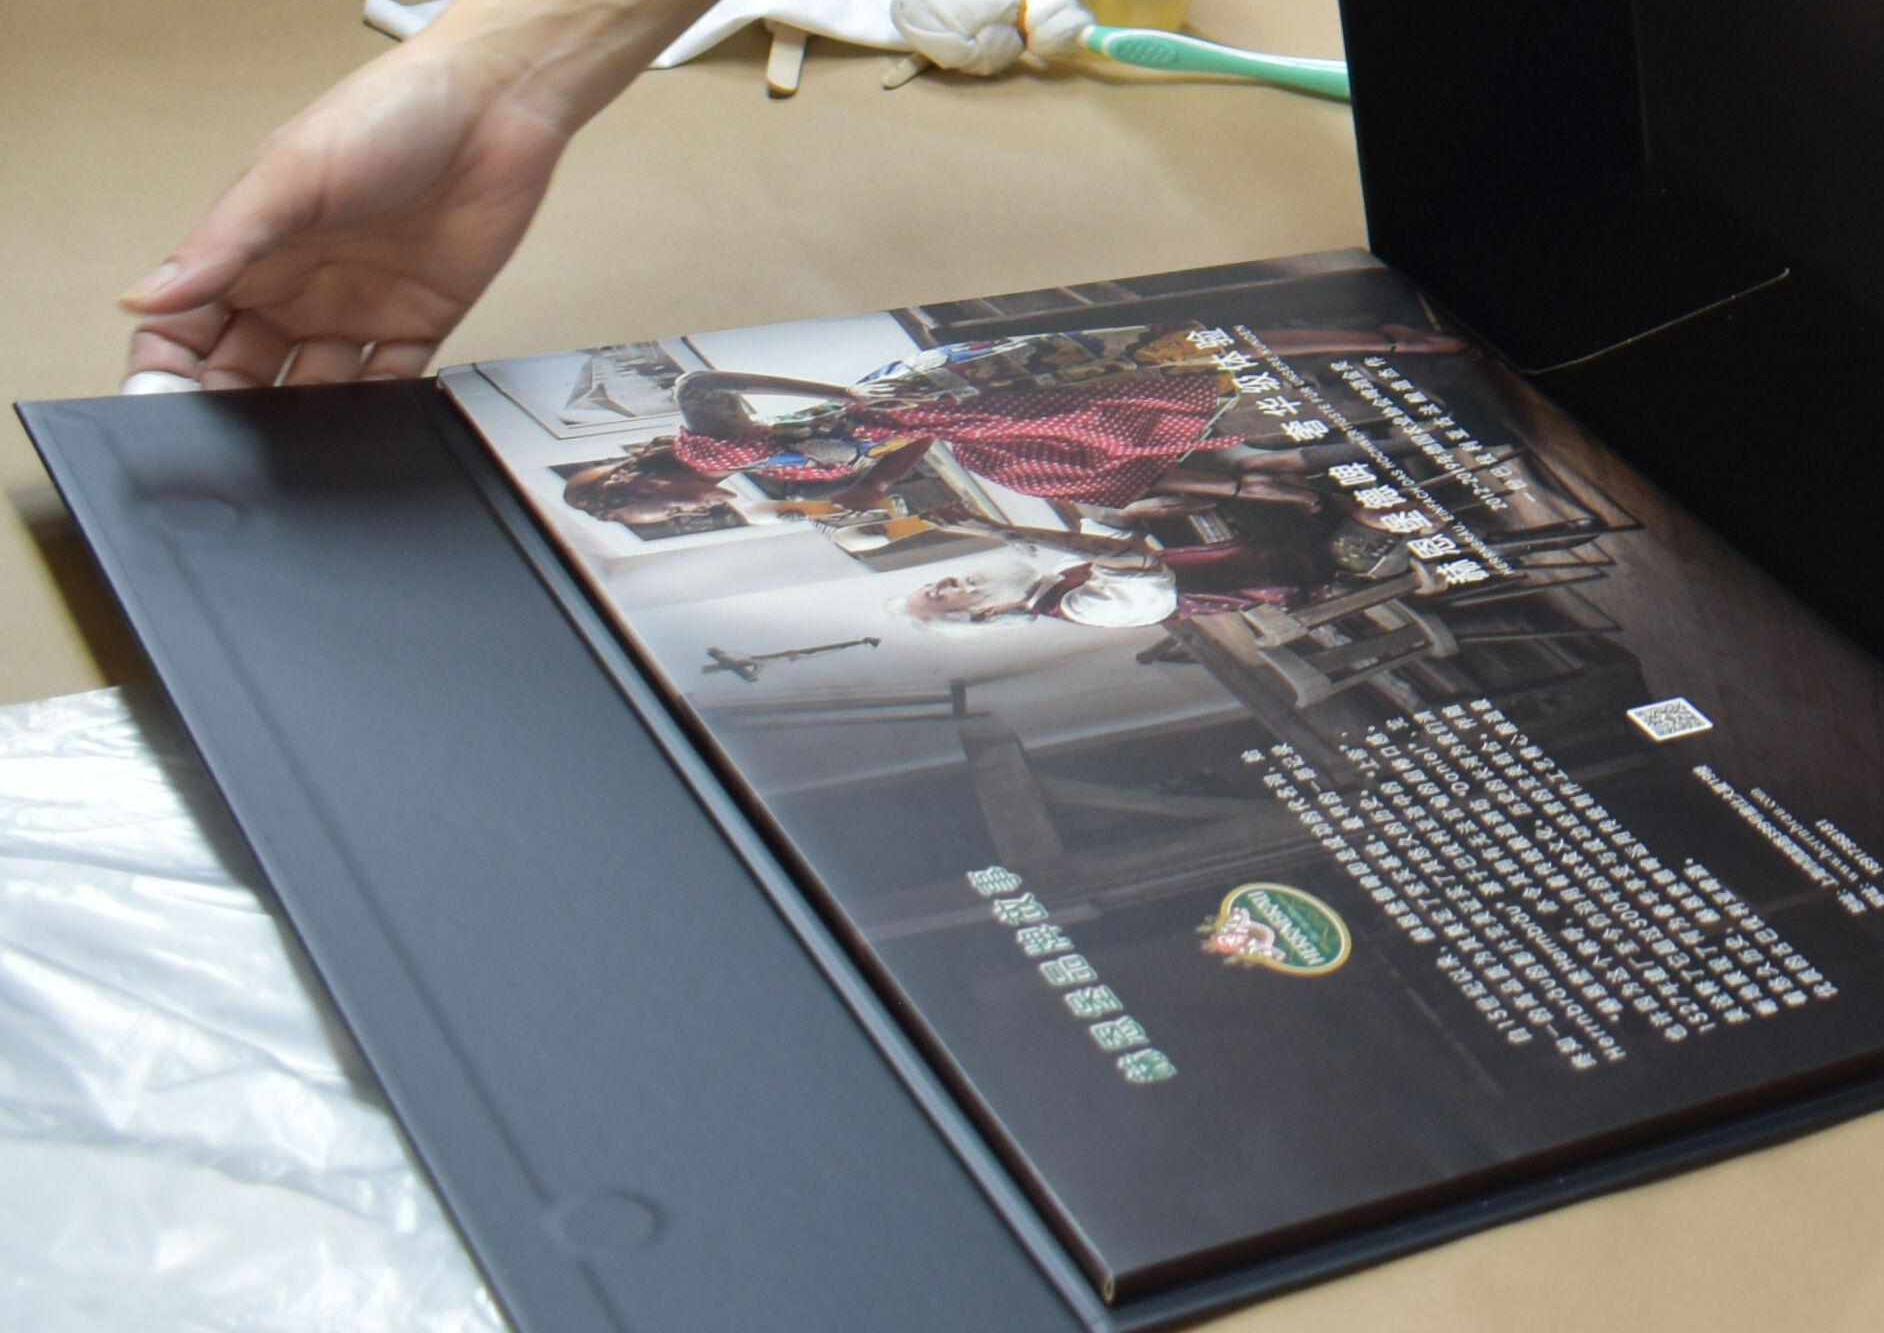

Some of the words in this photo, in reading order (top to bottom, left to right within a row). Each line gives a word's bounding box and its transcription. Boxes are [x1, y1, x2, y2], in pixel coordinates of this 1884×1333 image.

[1229, 324, 1275, 355] KUNDEN
[1186, 327, 1330, 441] 奢华级体验
[1388, 468, 1419, 486] DAS
[1408, 486, 1458, 521] EINFACH
[1326, 462, 1493, 583] 赫恩堡德啤
[966, 865, 1181, 1085] 赫恩堡品牌故事
